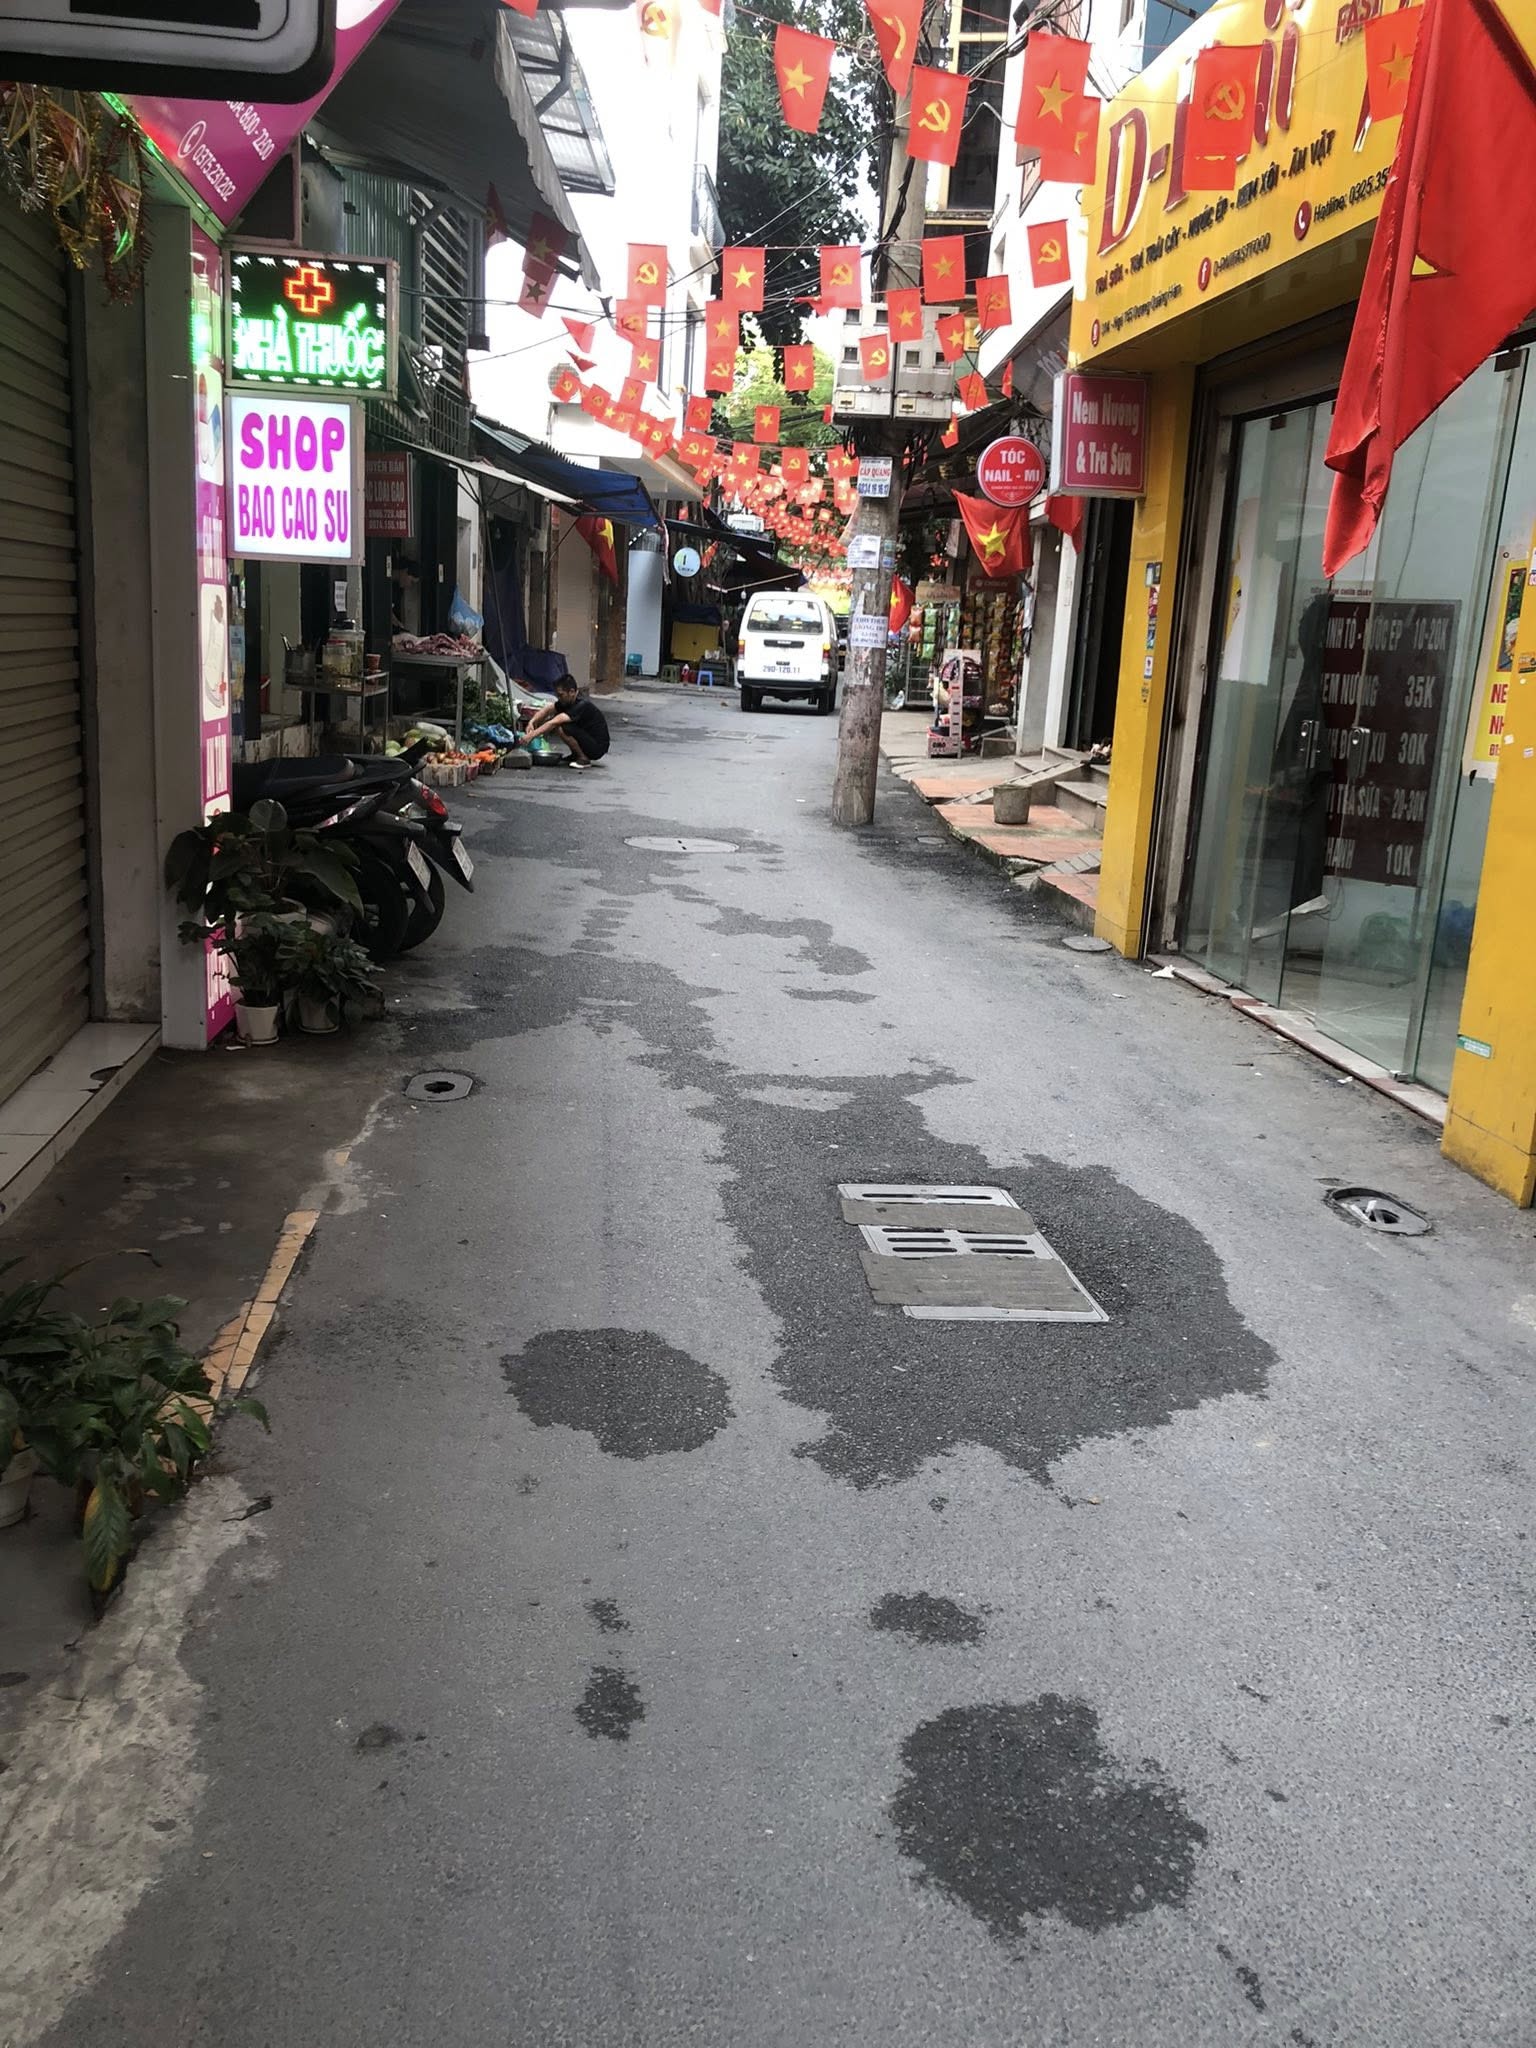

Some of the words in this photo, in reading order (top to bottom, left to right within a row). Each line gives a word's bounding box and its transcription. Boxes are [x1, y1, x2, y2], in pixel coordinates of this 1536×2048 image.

[1313, 192, 1347, 223] Hotline:
[1348, 163, 1393, 205] 0325.35
[233, 304, 294, 372] NHÀ
[294, 302, 386, 379] THUỐC
[1072, 391, 1099, 425] Nem
[1102, 393, 1140, 436] Nướng
[240, 412, 345, 473] SHOP
[1000, 448, 1026, 464] TÓC
[1076, 440, 1086, 474] &
[1088, 441, 1108, 475] Trà
[985, 469, 1013, 482] NAIL
[1024, 469, 1040, 482] MI
[239, 484, 276, 538] BAO
[282, 486, 317, 541] CAO
[324, 488, 348, 544] SU
[1326, 617, 1345, 649] INH
[1322, 673, 1340, 704] EM
[1405, 675, 1436, 708] 35K
[1398, 732, 1428, 766] 30K
[1386, 844, 1414, 876] 10K
